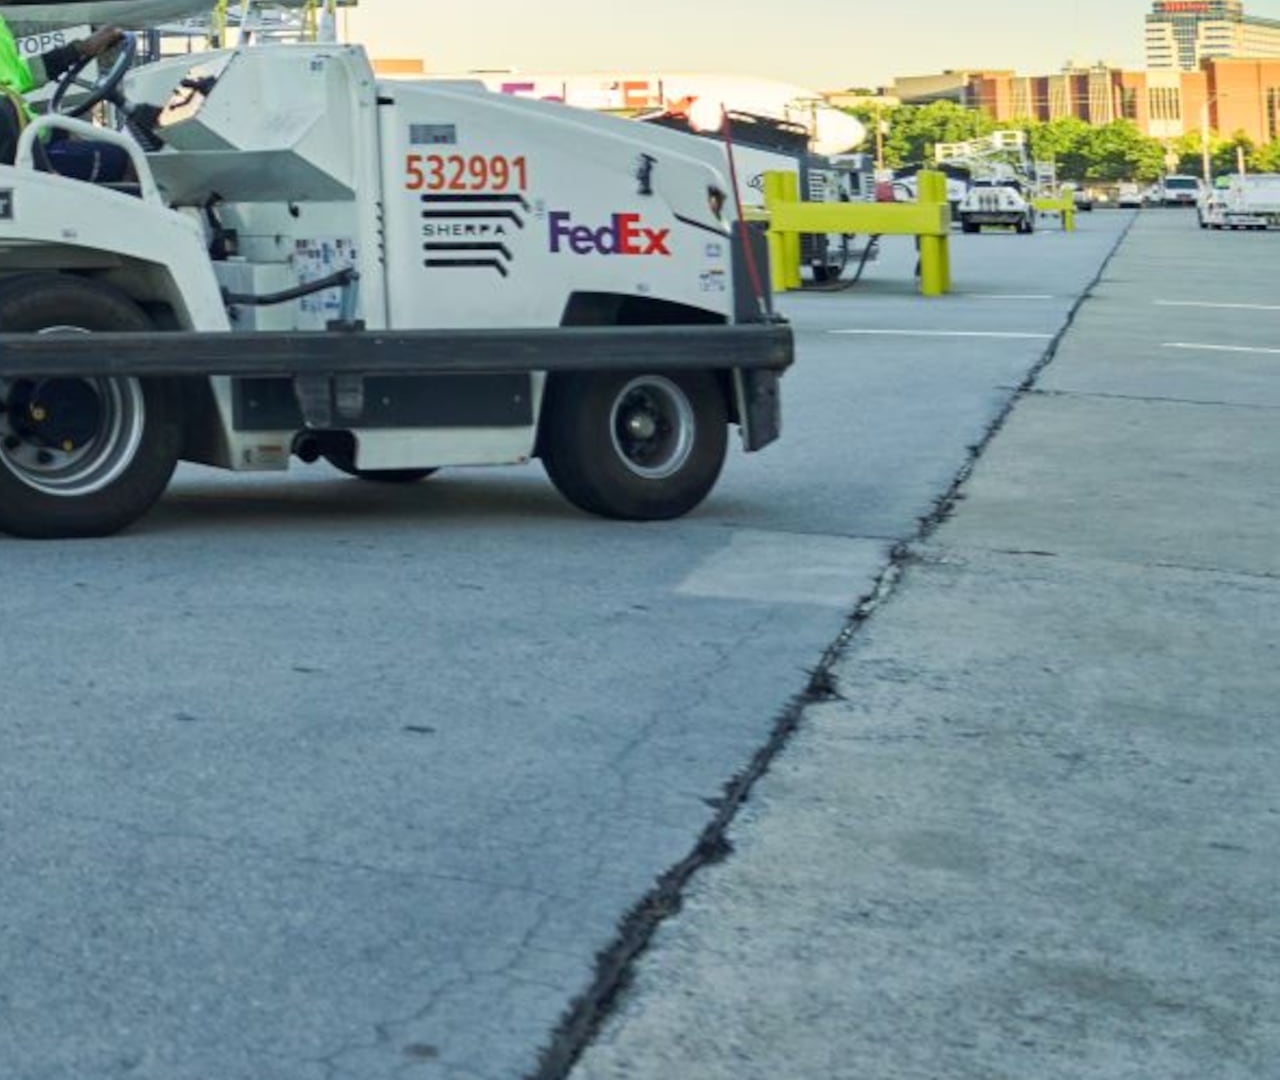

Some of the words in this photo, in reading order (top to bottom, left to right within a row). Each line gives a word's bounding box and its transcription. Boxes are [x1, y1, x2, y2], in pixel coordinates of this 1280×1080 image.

[19, 32, 66, 54] OPS
[404, 154, 527, 191] 532991
[422, 223, 506, 237] SHERPA
[548, 211, 672, 256] FedEx
